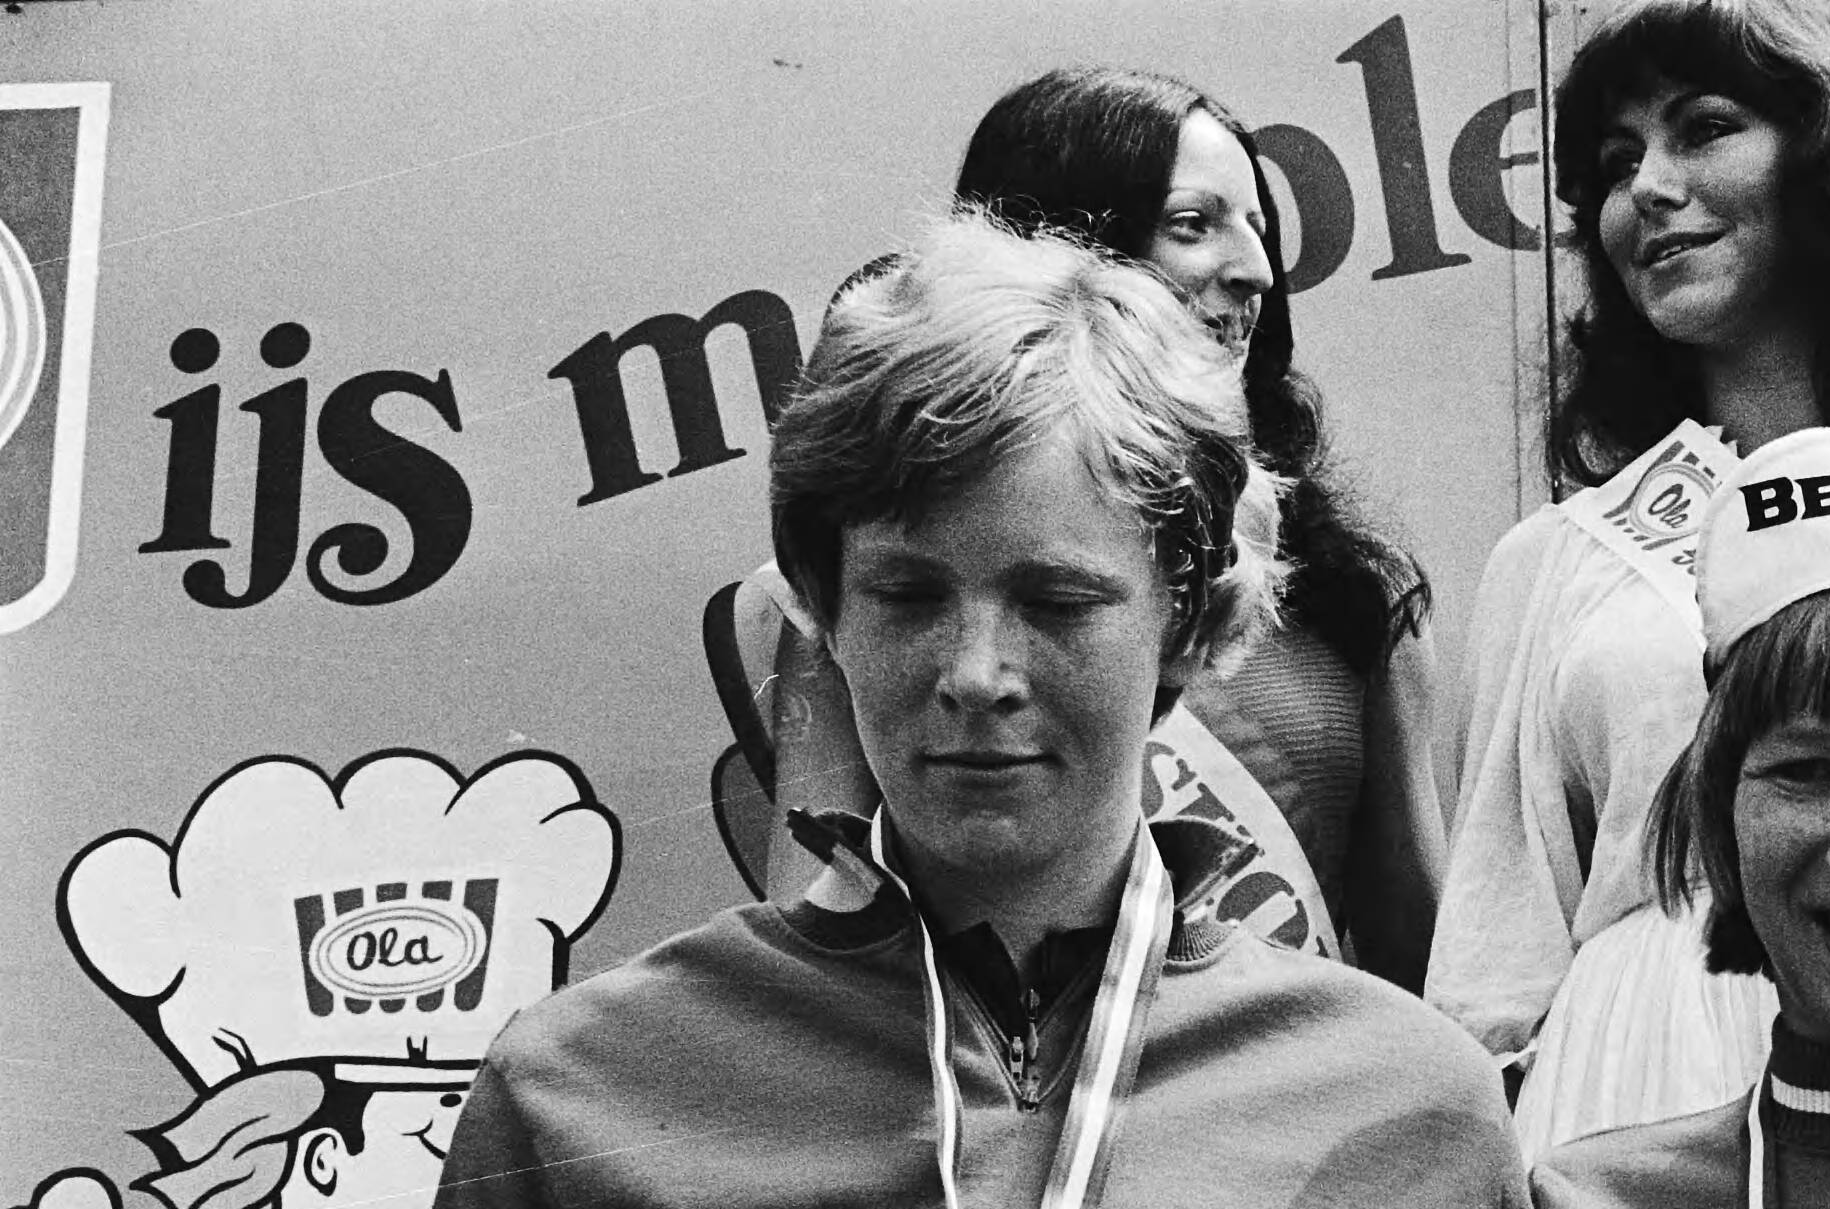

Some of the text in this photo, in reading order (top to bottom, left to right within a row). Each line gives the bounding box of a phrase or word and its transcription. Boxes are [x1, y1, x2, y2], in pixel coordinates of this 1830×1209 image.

[138, 321, 474, 610] ijs
[1646, 482, 1690, 530] Ola
[346, 927, 443, 971] Ola
